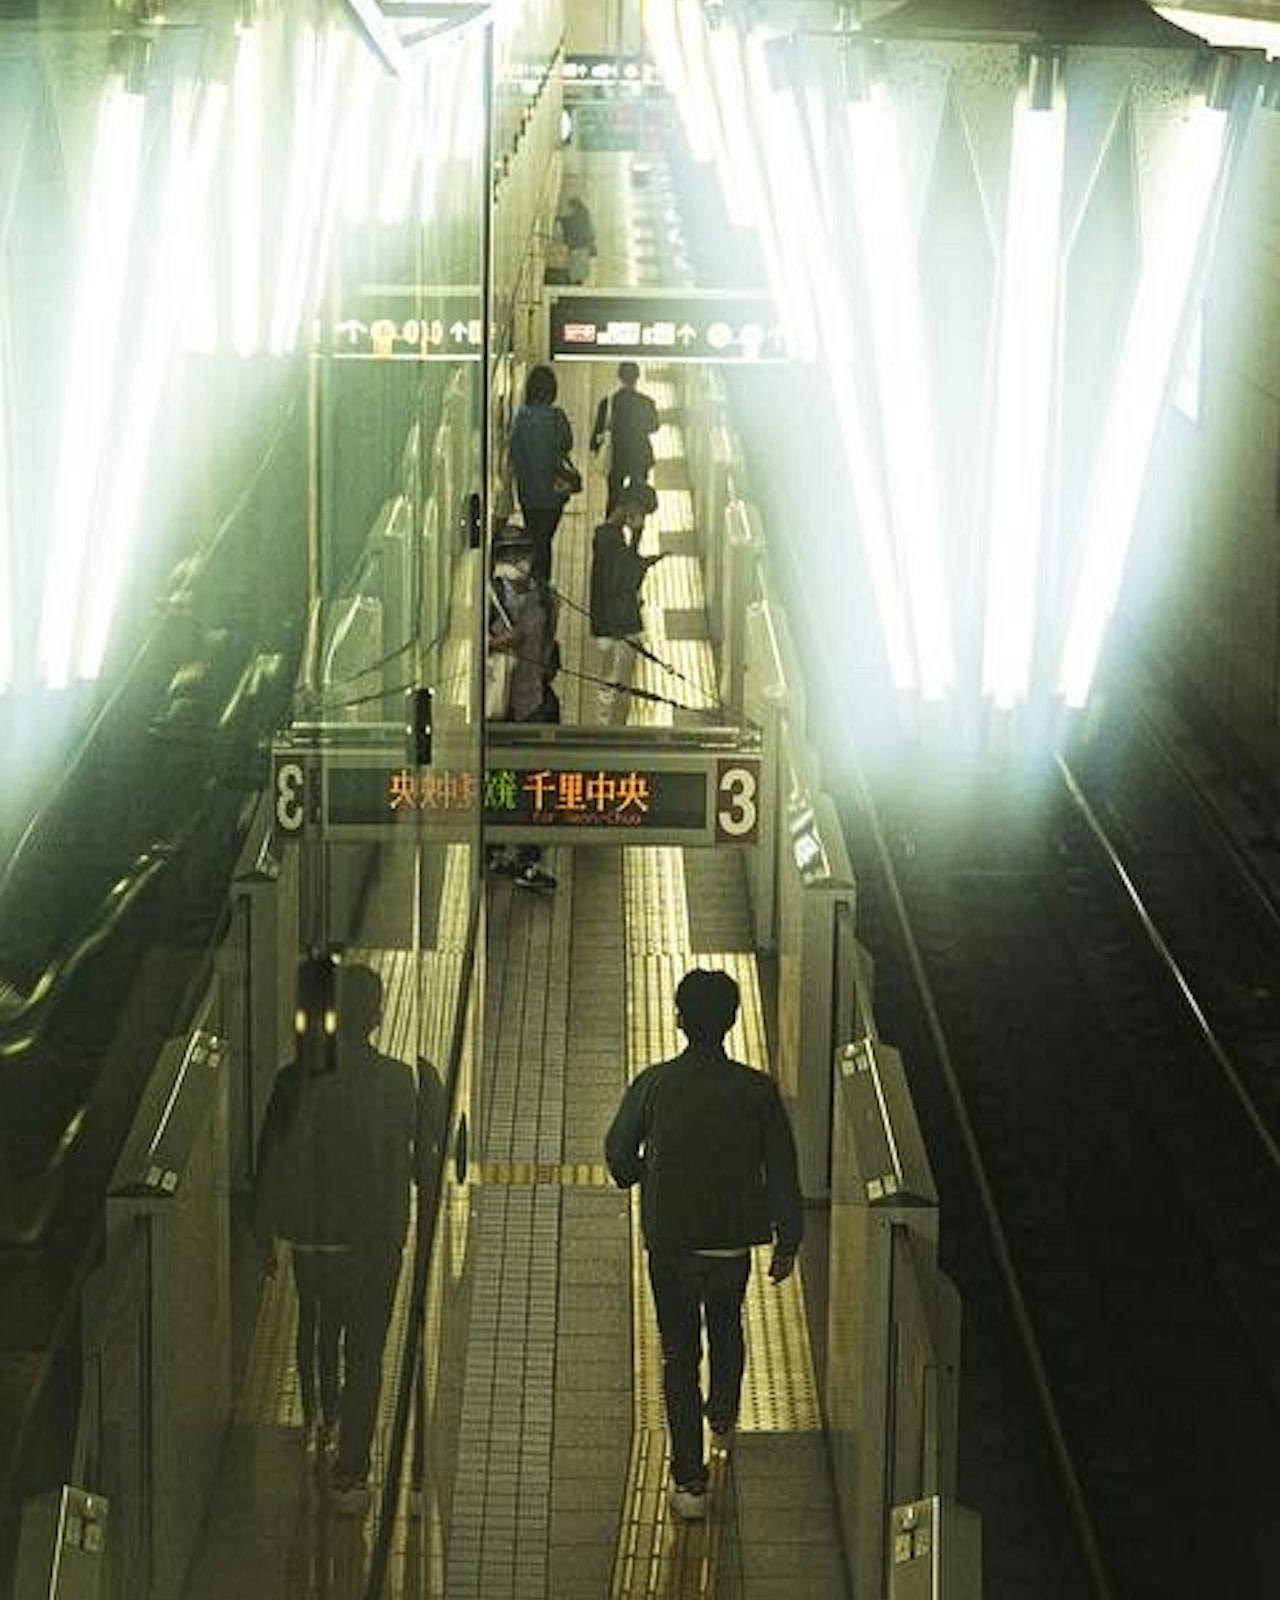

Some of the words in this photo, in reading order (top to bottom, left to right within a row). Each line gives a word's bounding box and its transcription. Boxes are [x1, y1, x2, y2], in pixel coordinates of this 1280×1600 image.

[522, 771, 650, 812] 千里中央
[719, 768, 757, 835] 3
